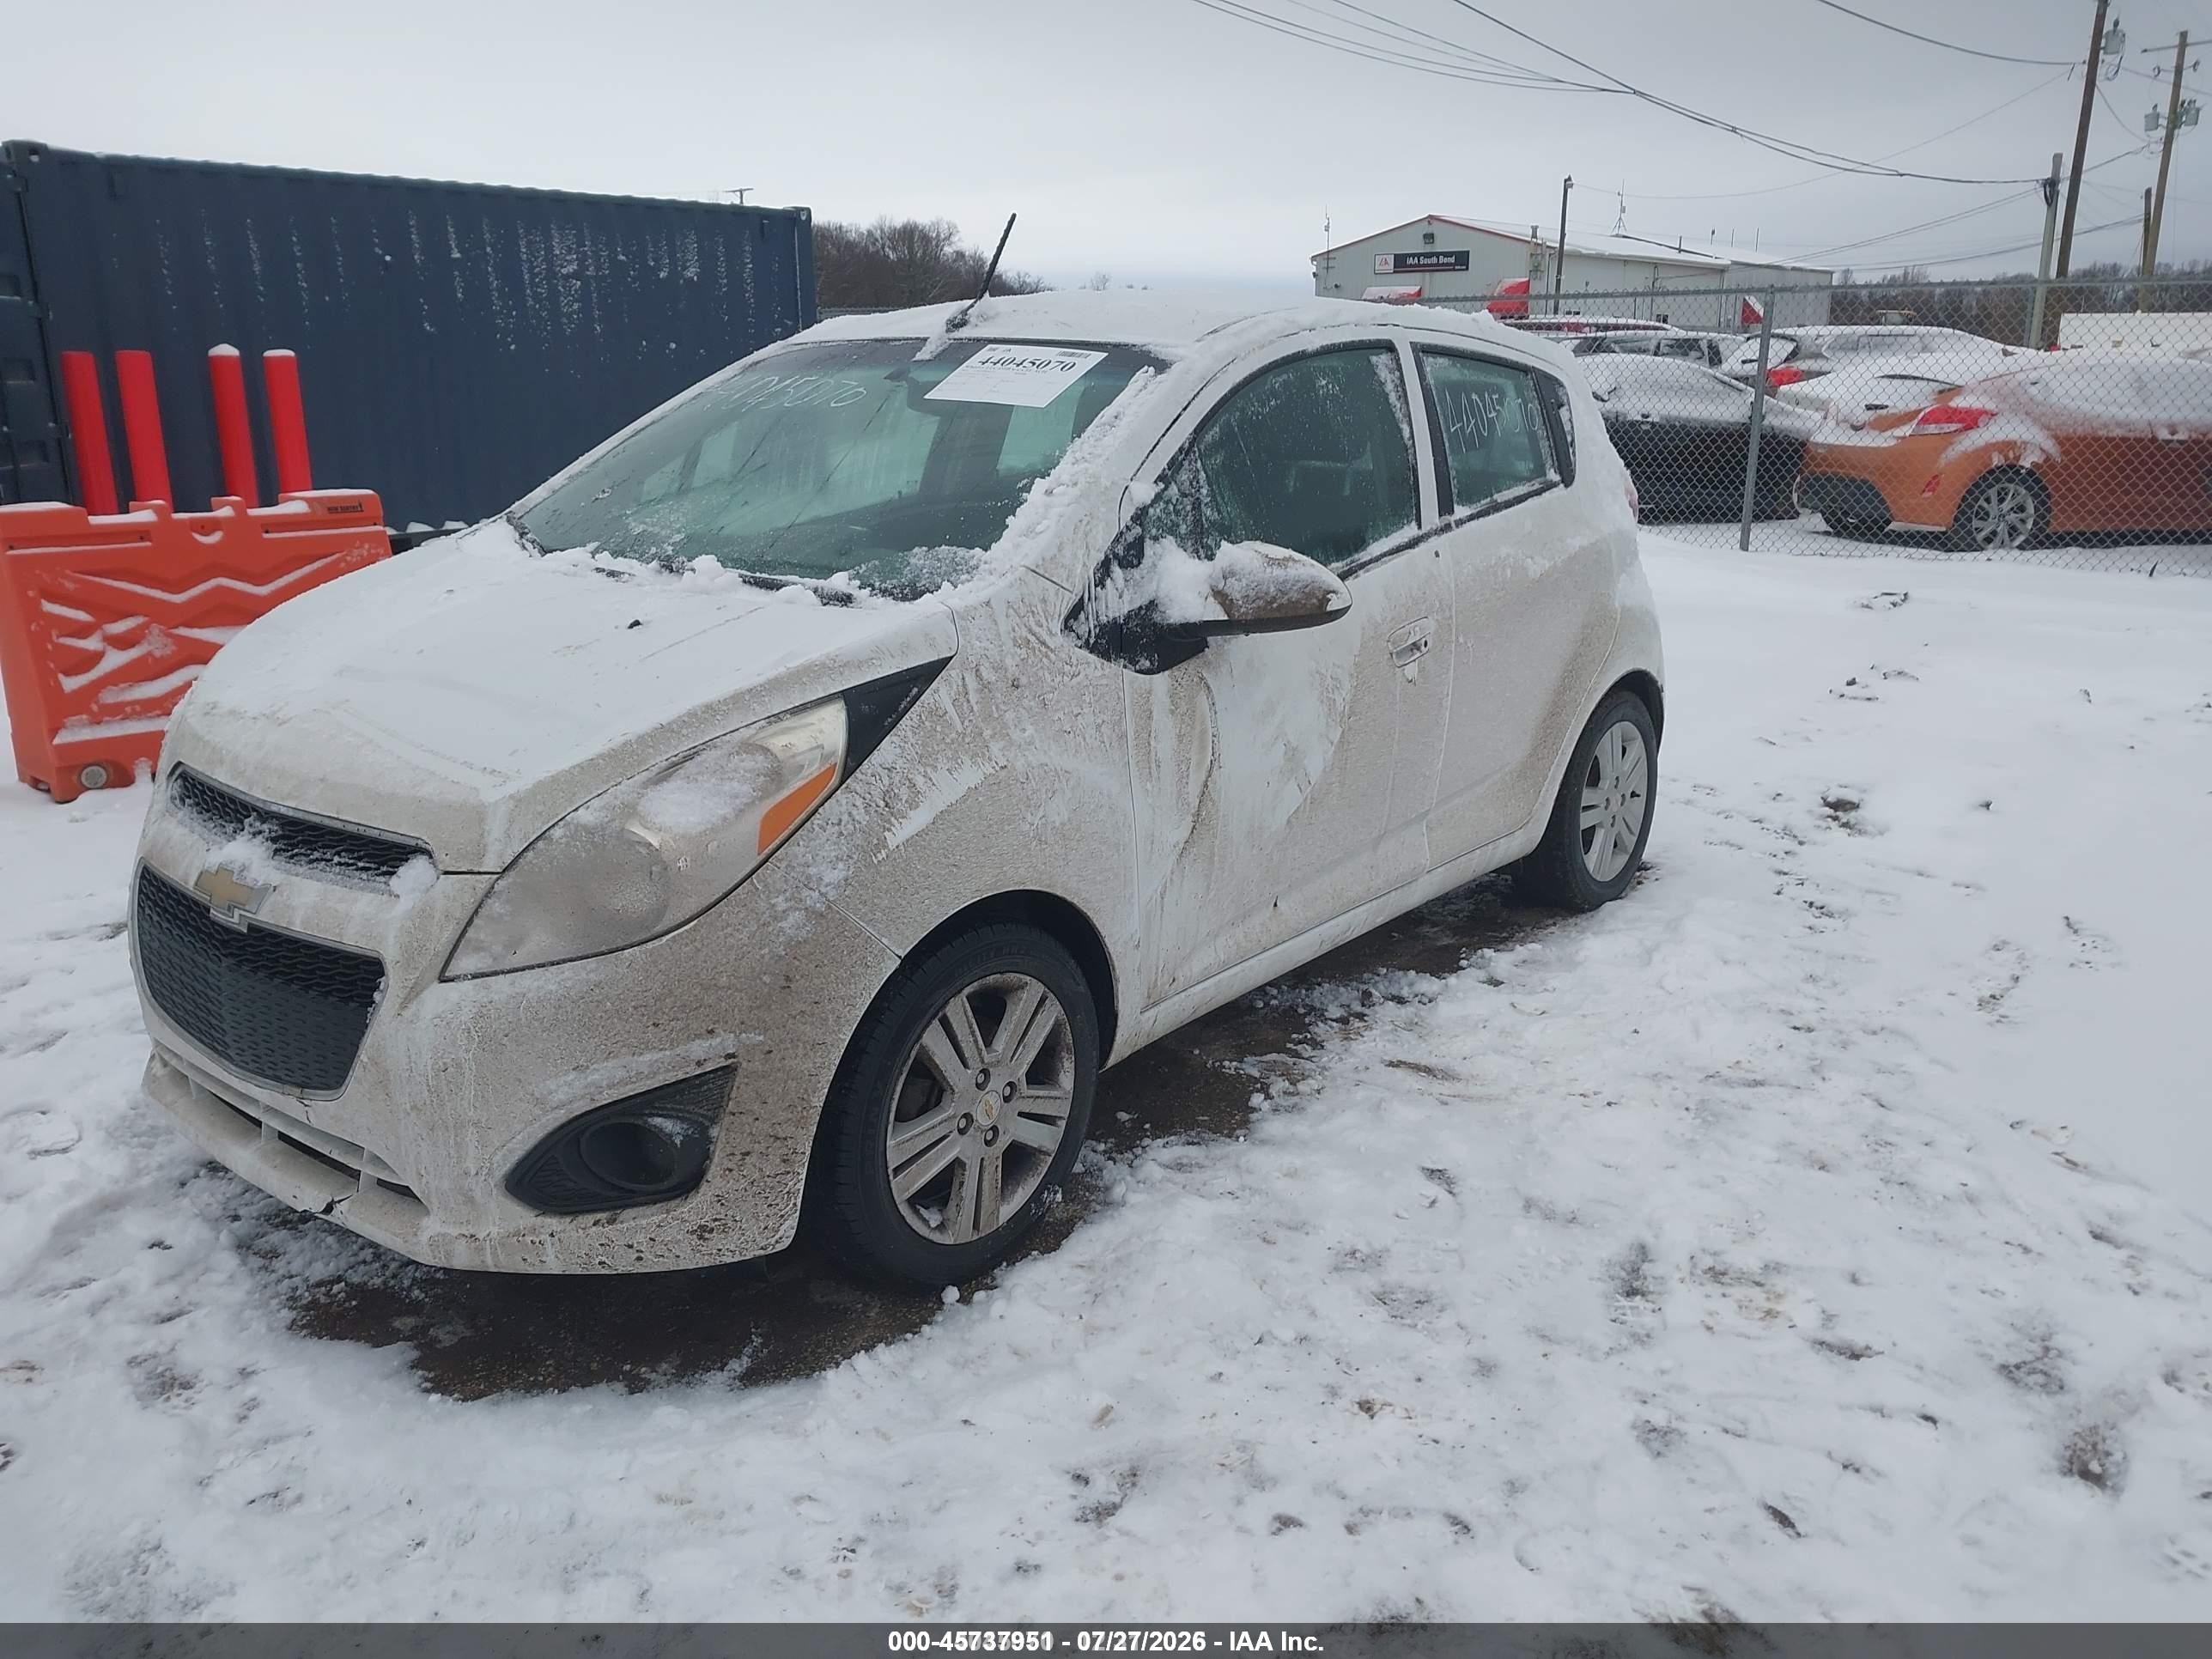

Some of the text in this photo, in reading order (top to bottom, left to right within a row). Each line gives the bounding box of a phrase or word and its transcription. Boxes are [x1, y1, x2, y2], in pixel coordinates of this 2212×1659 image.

[1407, 256, 1418, 264] IAA
[1419, 255, 1437, 264] South
[978, 355, 1077, 373] 44045070
